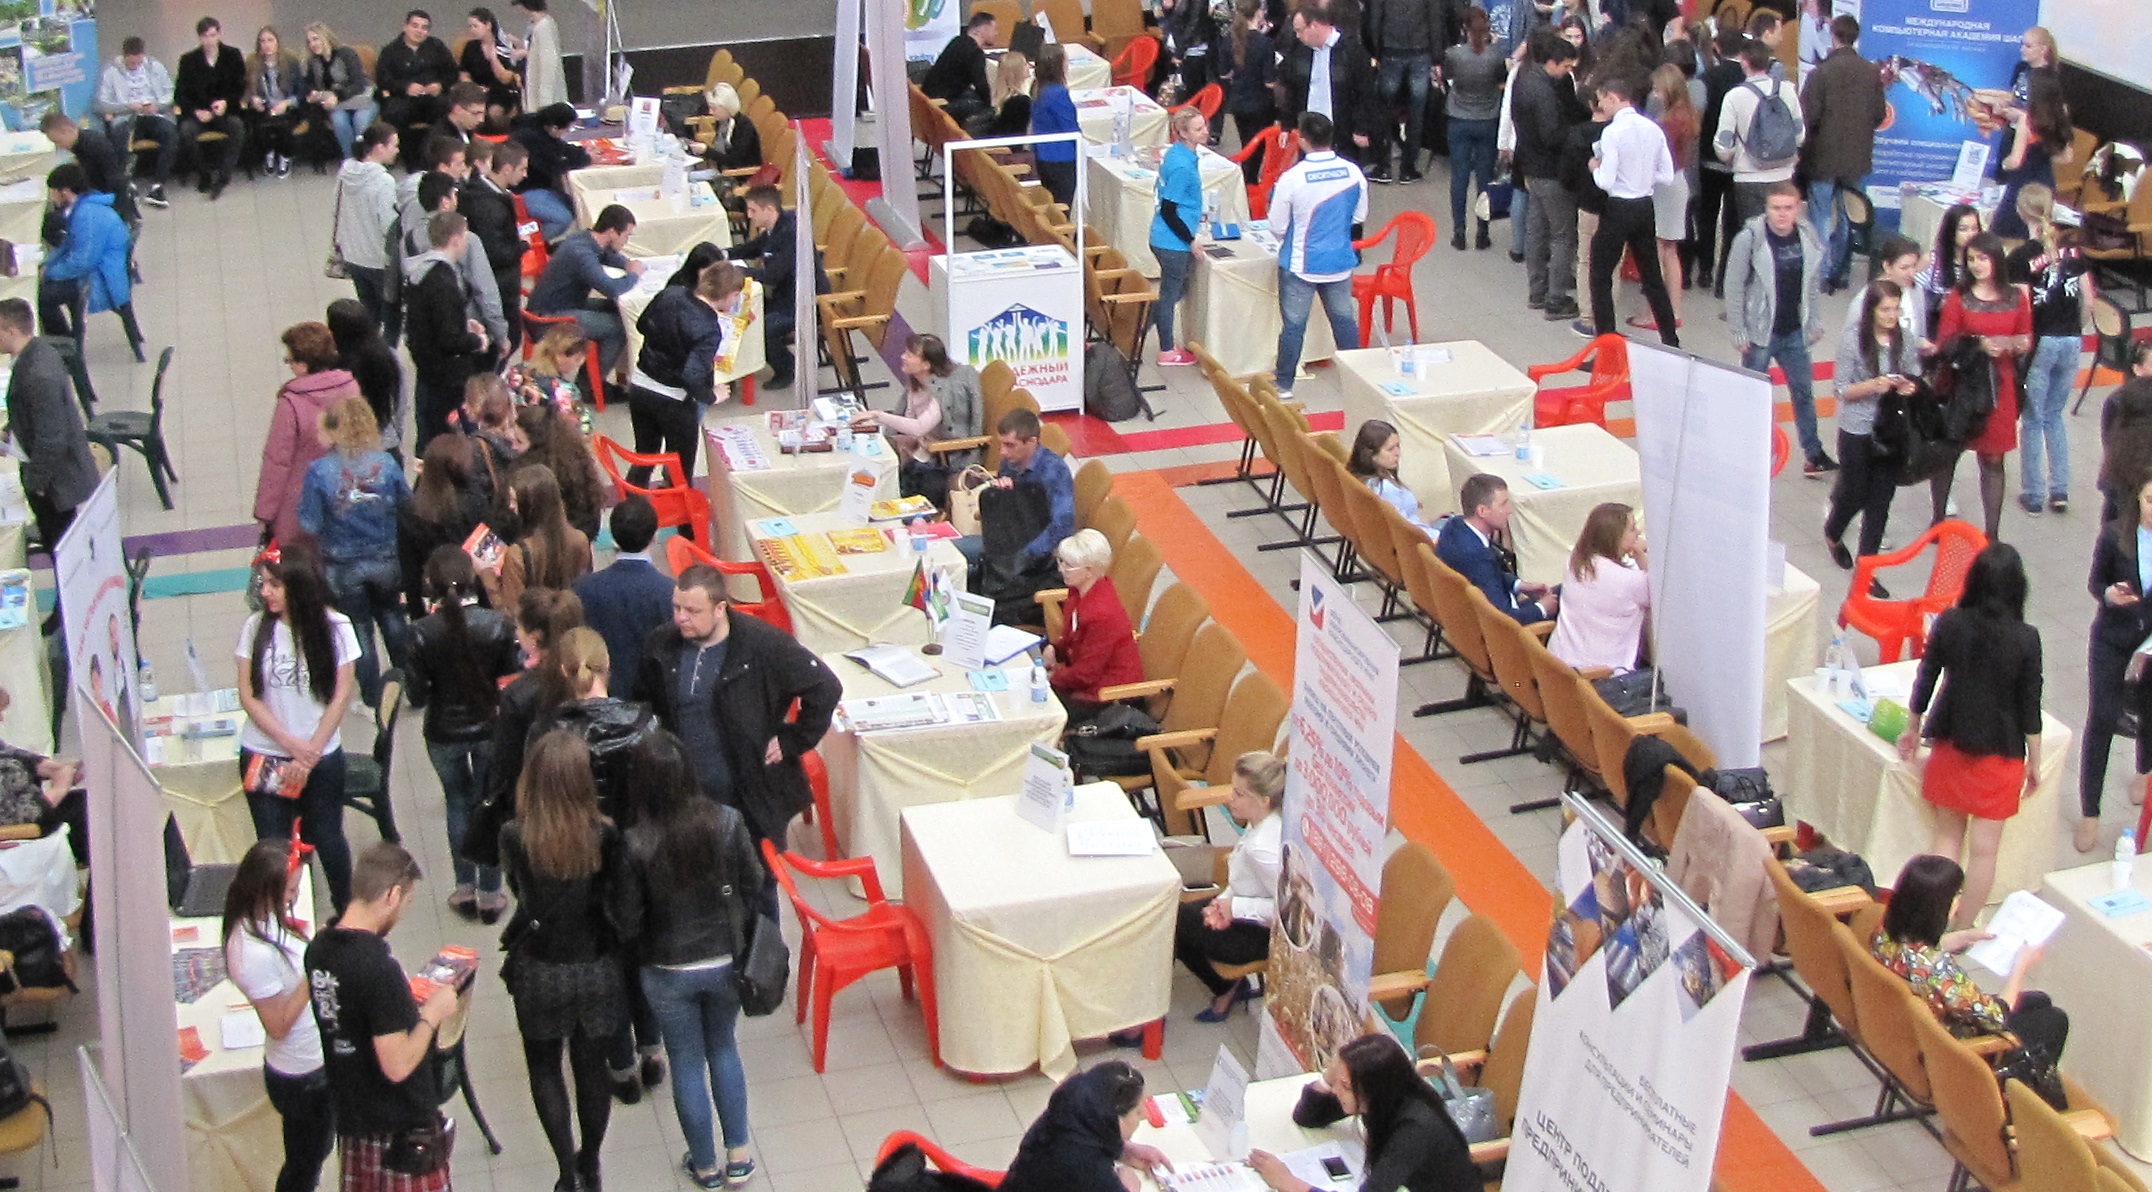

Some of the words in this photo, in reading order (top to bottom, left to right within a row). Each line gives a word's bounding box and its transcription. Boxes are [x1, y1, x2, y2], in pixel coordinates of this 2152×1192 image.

[1872, 24, 1949, 37] КОМПЬЮТЕРНАЯ
[1950, 31, 2001, 42] АКАДЕМИЯ
[1905, 16, 1991, 31] МЕЖДУНАРОДНАЯ
[1639, 1075, 1697, 1136] БЕСПЛАТНЫЕ
[1536, 1109, 1573, 1155] ЦЕНТР
